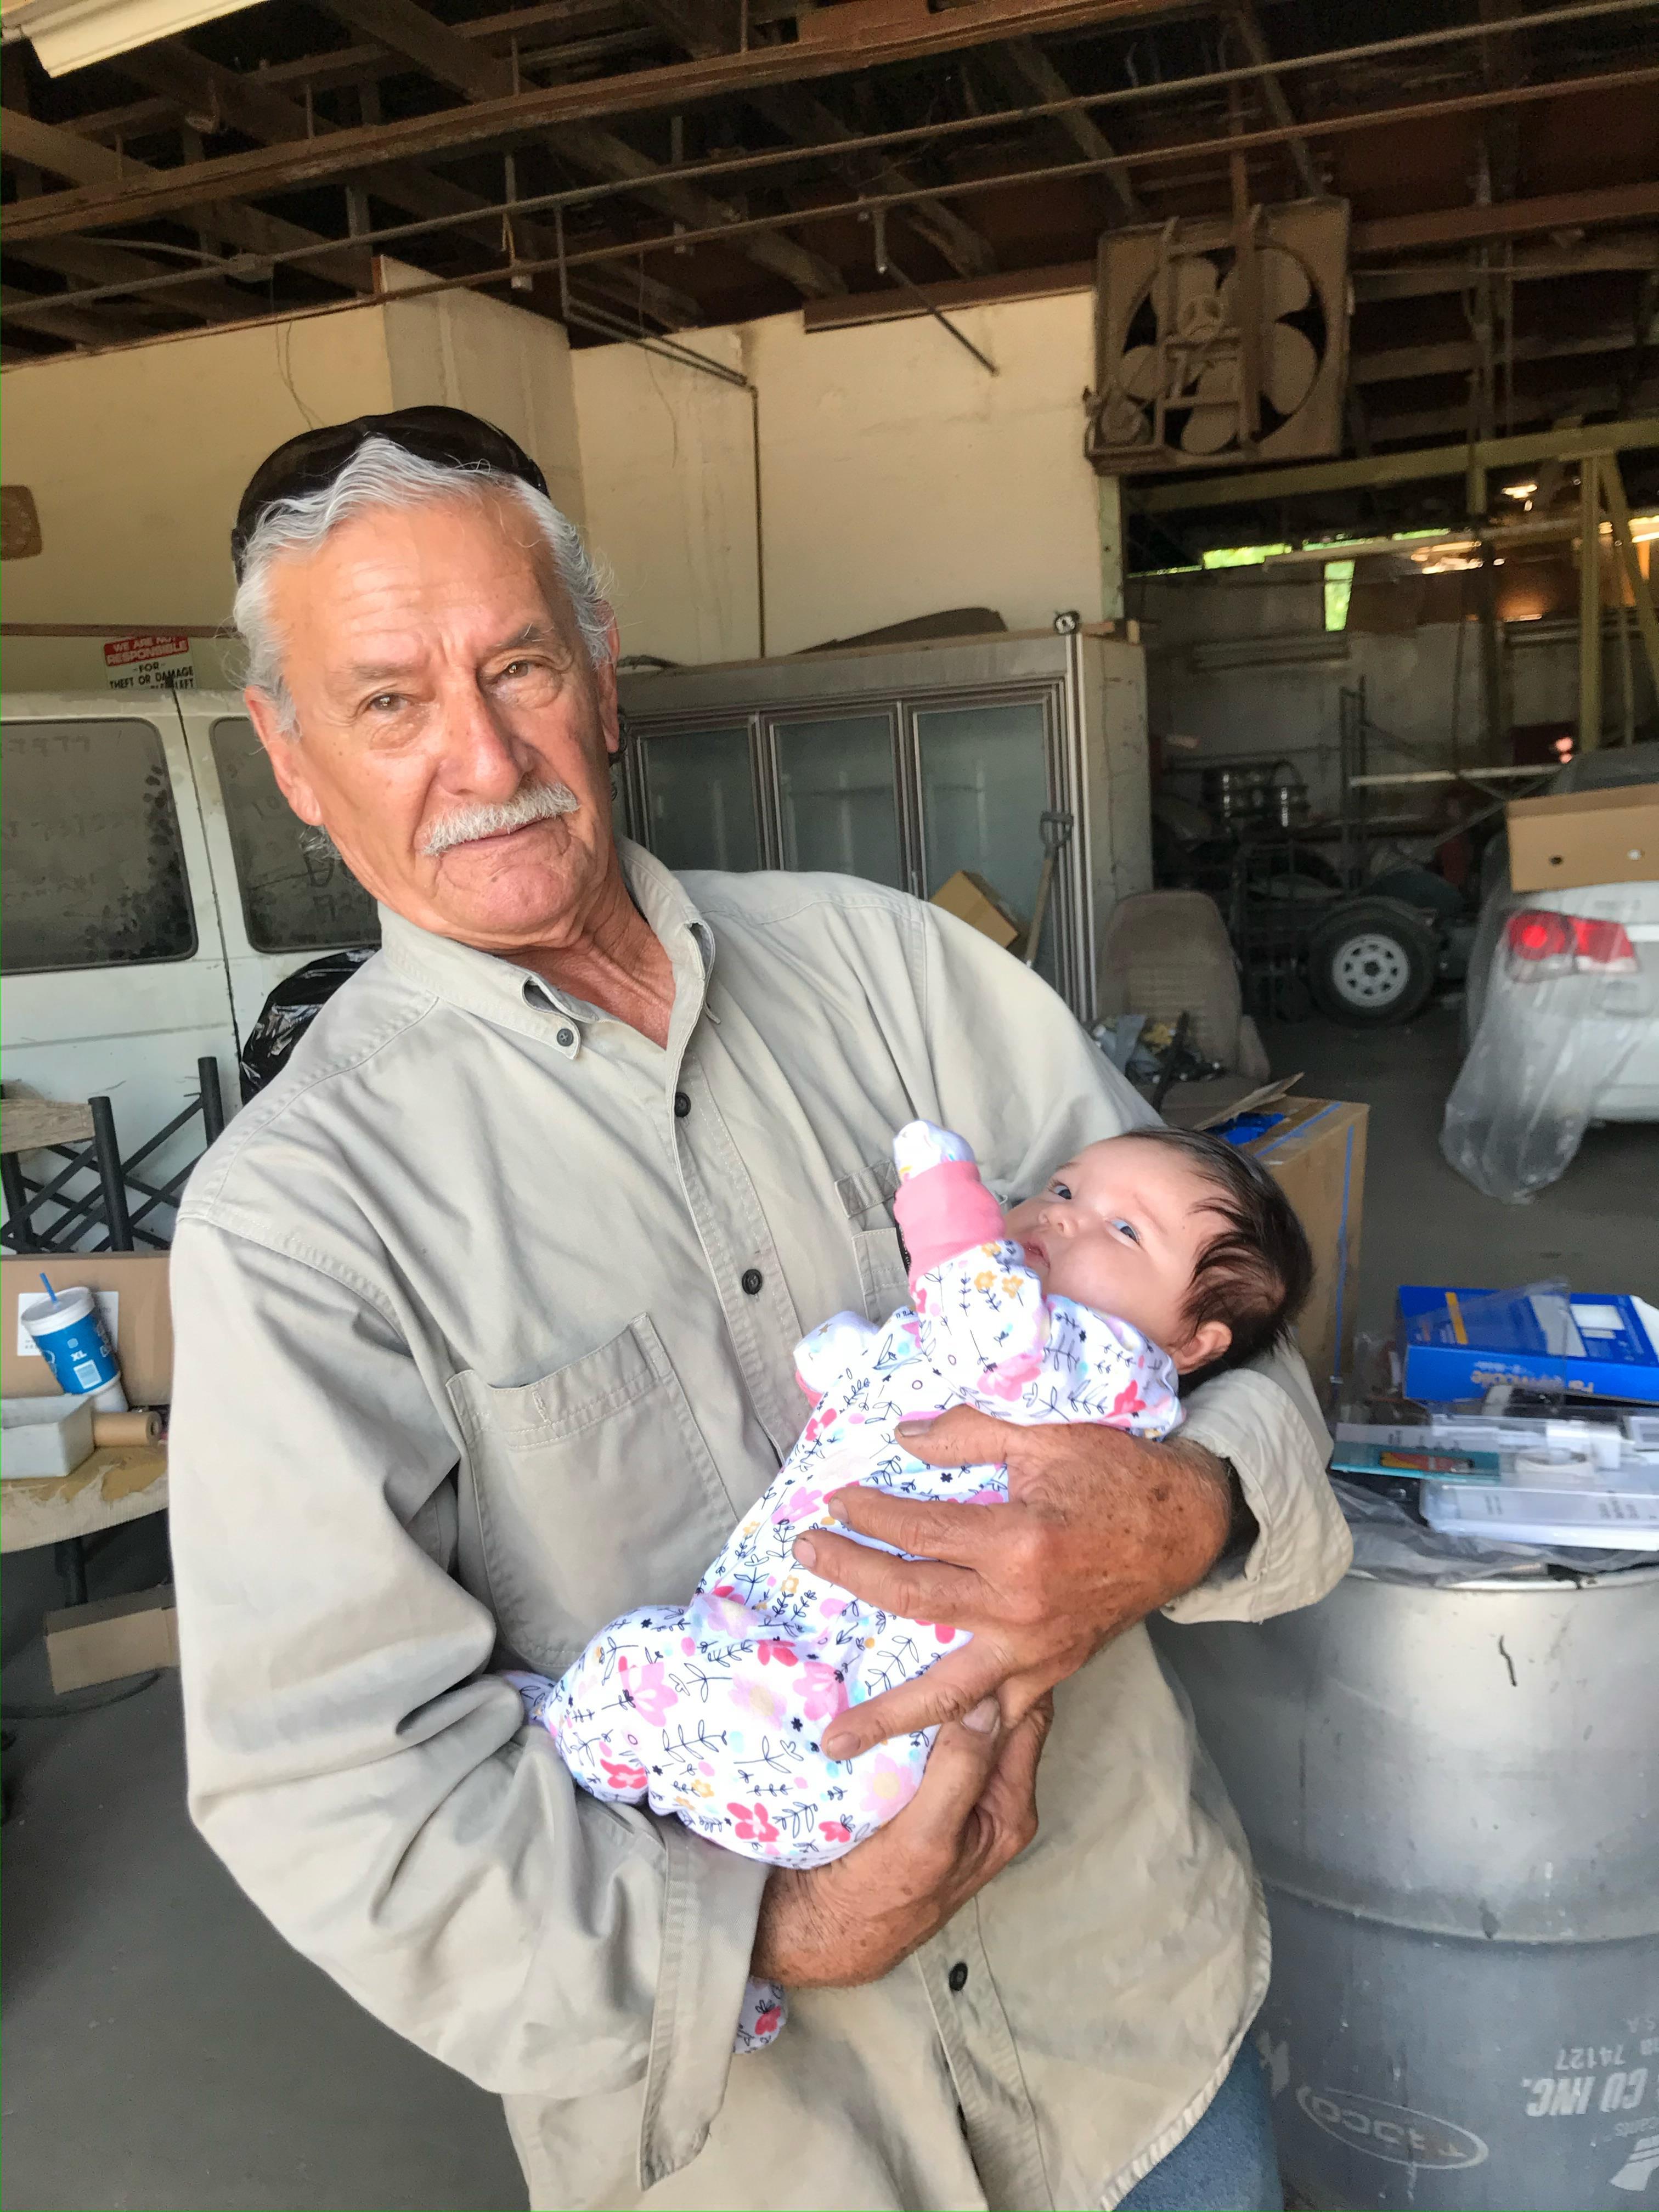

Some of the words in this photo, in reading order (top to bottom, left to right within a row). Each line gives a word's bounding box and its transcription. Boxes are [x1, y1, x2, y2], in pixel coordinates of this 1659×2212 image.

[106, 640, 188, 665] RESPONSIBLE
[113, 642, 130, 652] WE
[134, 637, 153, 649] ARE
[110, 677, 134, 689] THEFT
[138, 674, 151, 685] OR
[155, 665, 194, 682] DAMAGE
[139, 662, 159, 673] FOR
[70, 1350, 87, 1362] XL
[1555, 2045, 1627, 2070] 74127
[1521, 2075, 1596, 2117] INC.
[1599, 2068, 1649, 2113] CO
